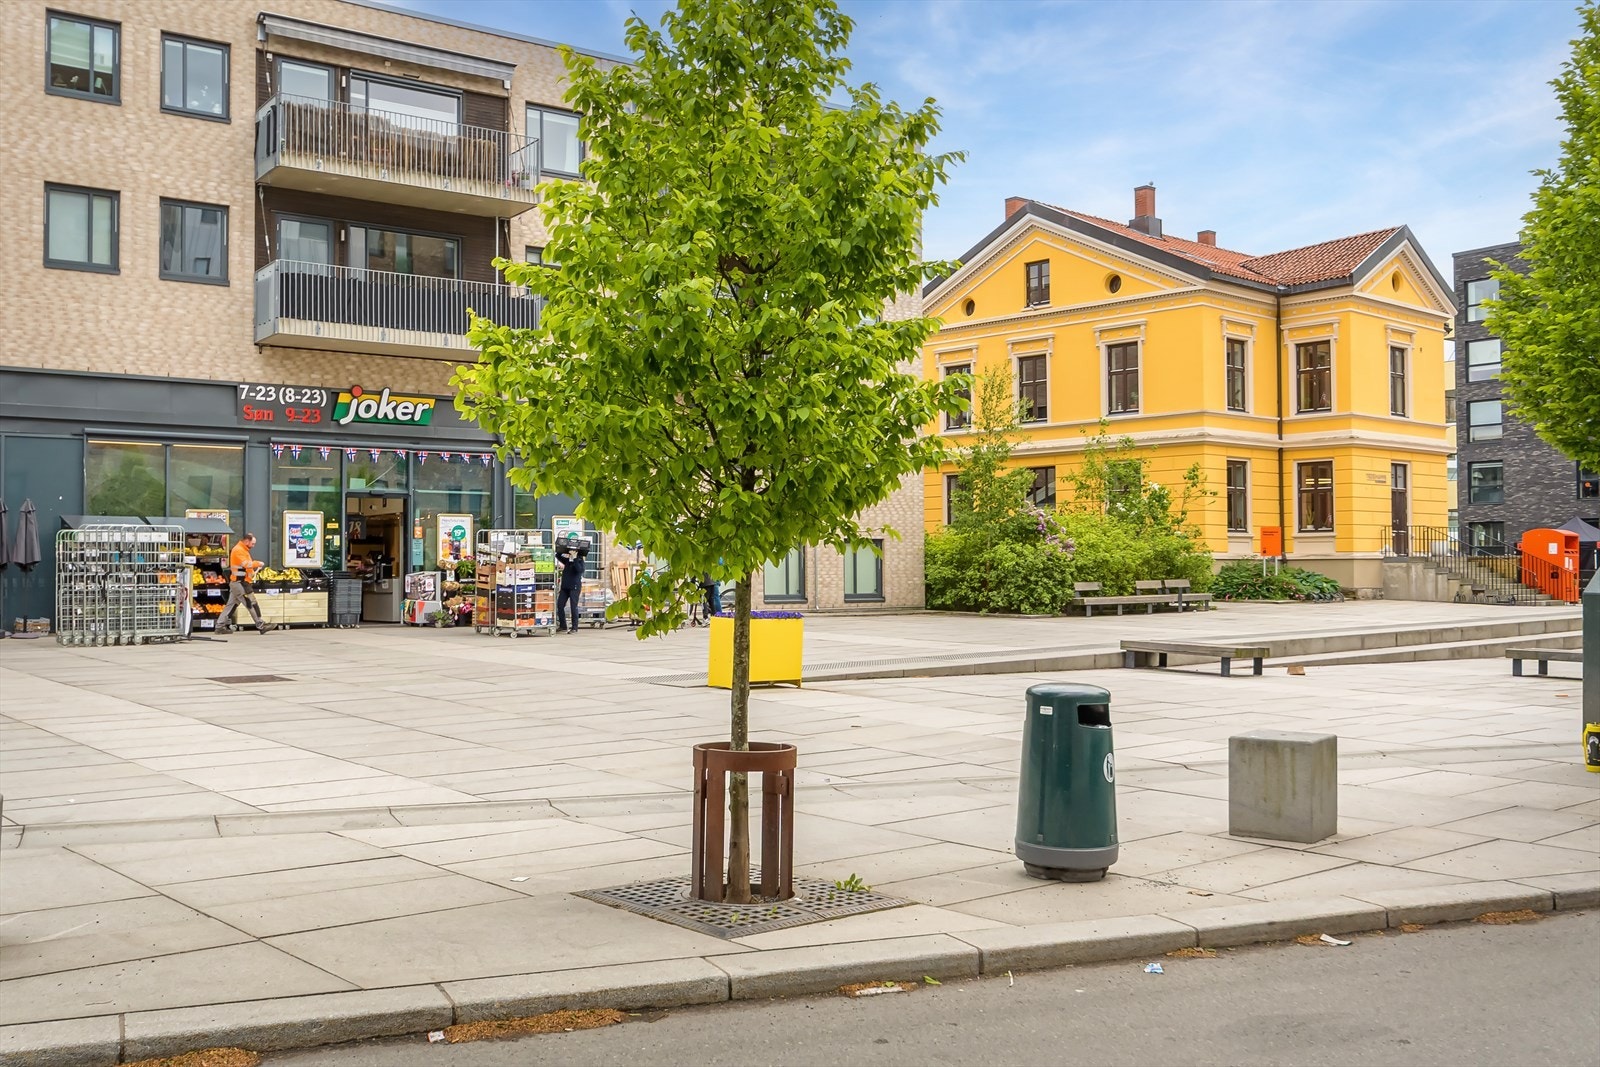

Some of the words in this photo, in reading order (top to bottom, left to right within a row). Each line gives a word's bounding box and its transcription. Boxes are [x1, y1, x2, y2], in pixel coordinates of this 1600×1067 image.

[239, 385, 276, 401] 7-23
[279, 387, 327, 407] (8-23)
[339, 385, 430, 425] joker
[243, 404, 274, 421] Søn
[285, 407, 321, 423] 9-23
